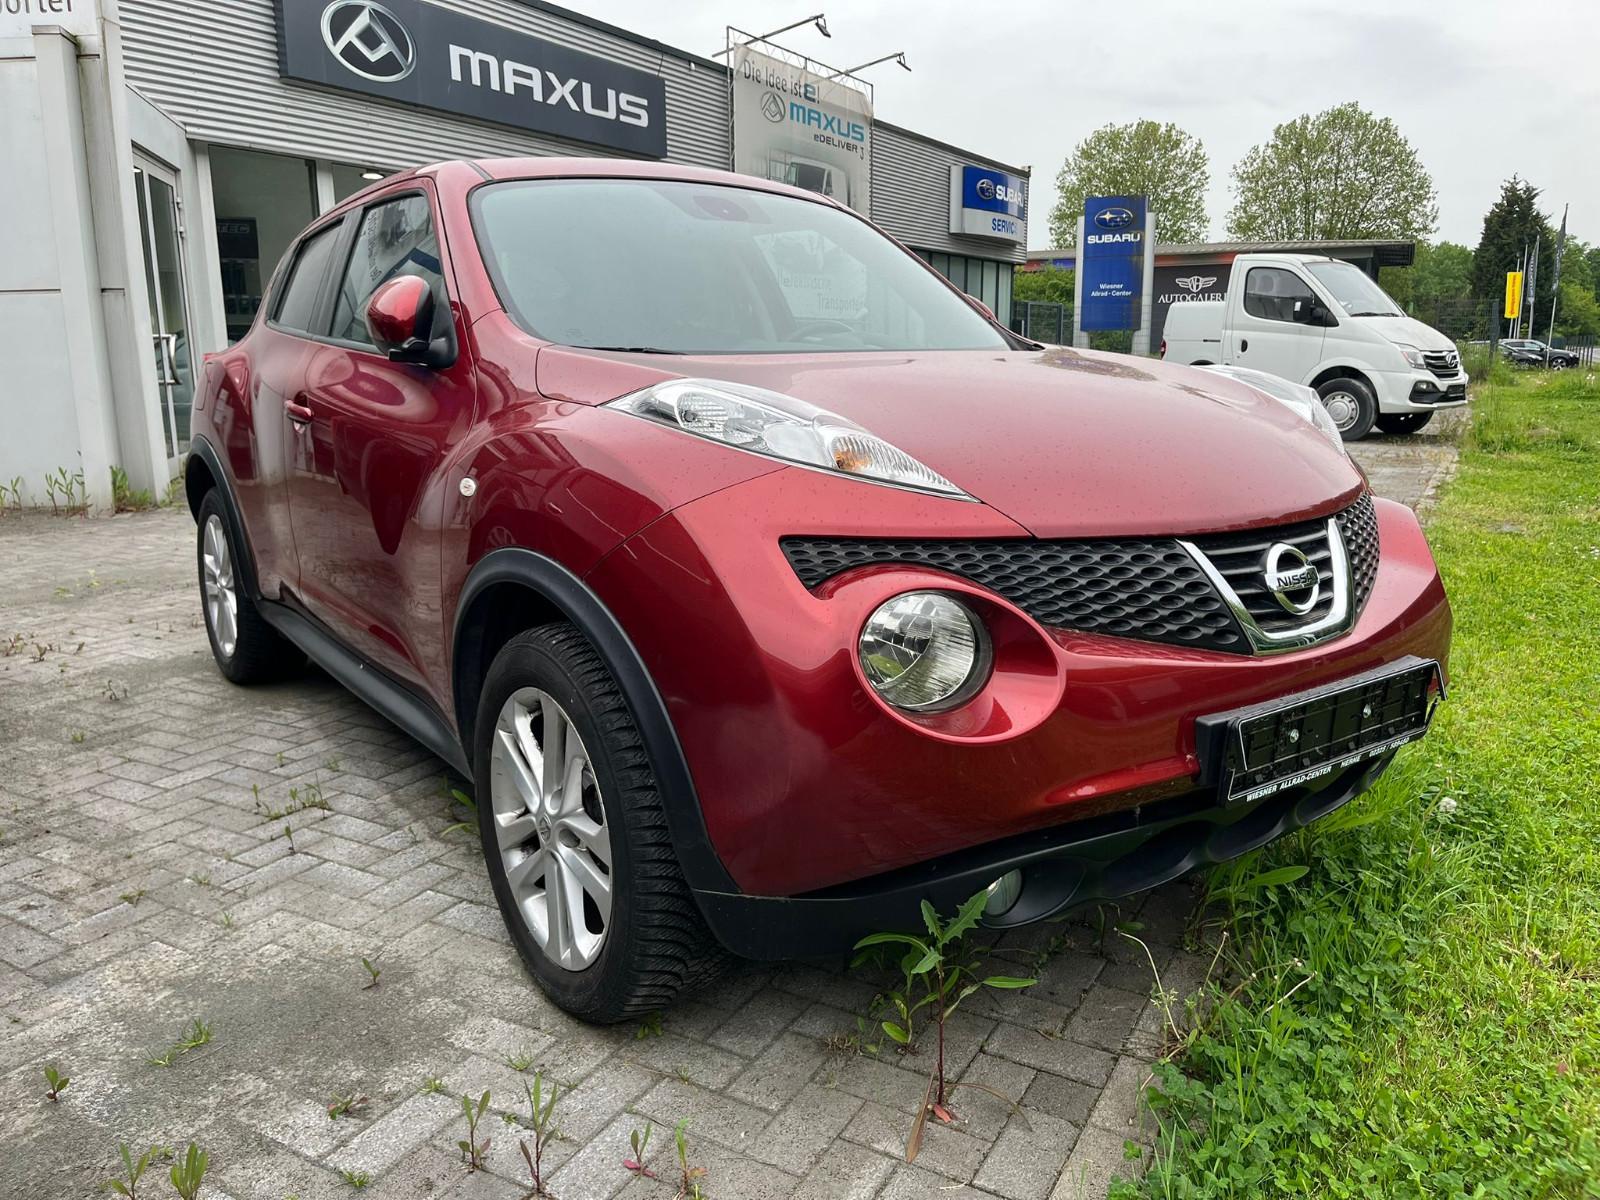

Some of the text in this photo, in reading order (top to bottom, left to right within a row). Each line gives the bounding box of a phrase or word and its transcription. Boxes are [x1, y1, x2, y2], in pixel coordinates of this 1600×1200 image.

[448, 43, 649, 128] MAXUS
[743, 58, 761, 84] Die
[765, 66, 787, 93] Idee
[790, 75, 802, 98] ist
[789, 101, 865, 143] MAXUS
[813, 133, 858, 153] eDELIVER
[991, 217, 1018, 236] SERVIC
[1087, 233, 1140, 244] SUBARU
[1158, 292, 1227, 303] AUTOGALERI
[1277, 571, 1315, 587] NISSA
[1246, 784, 1278, 802] WIESNER
[1279, 765, 1333, 791] ALLRAD-CENTER
[1340, 753, 1363, 768] HERNE
